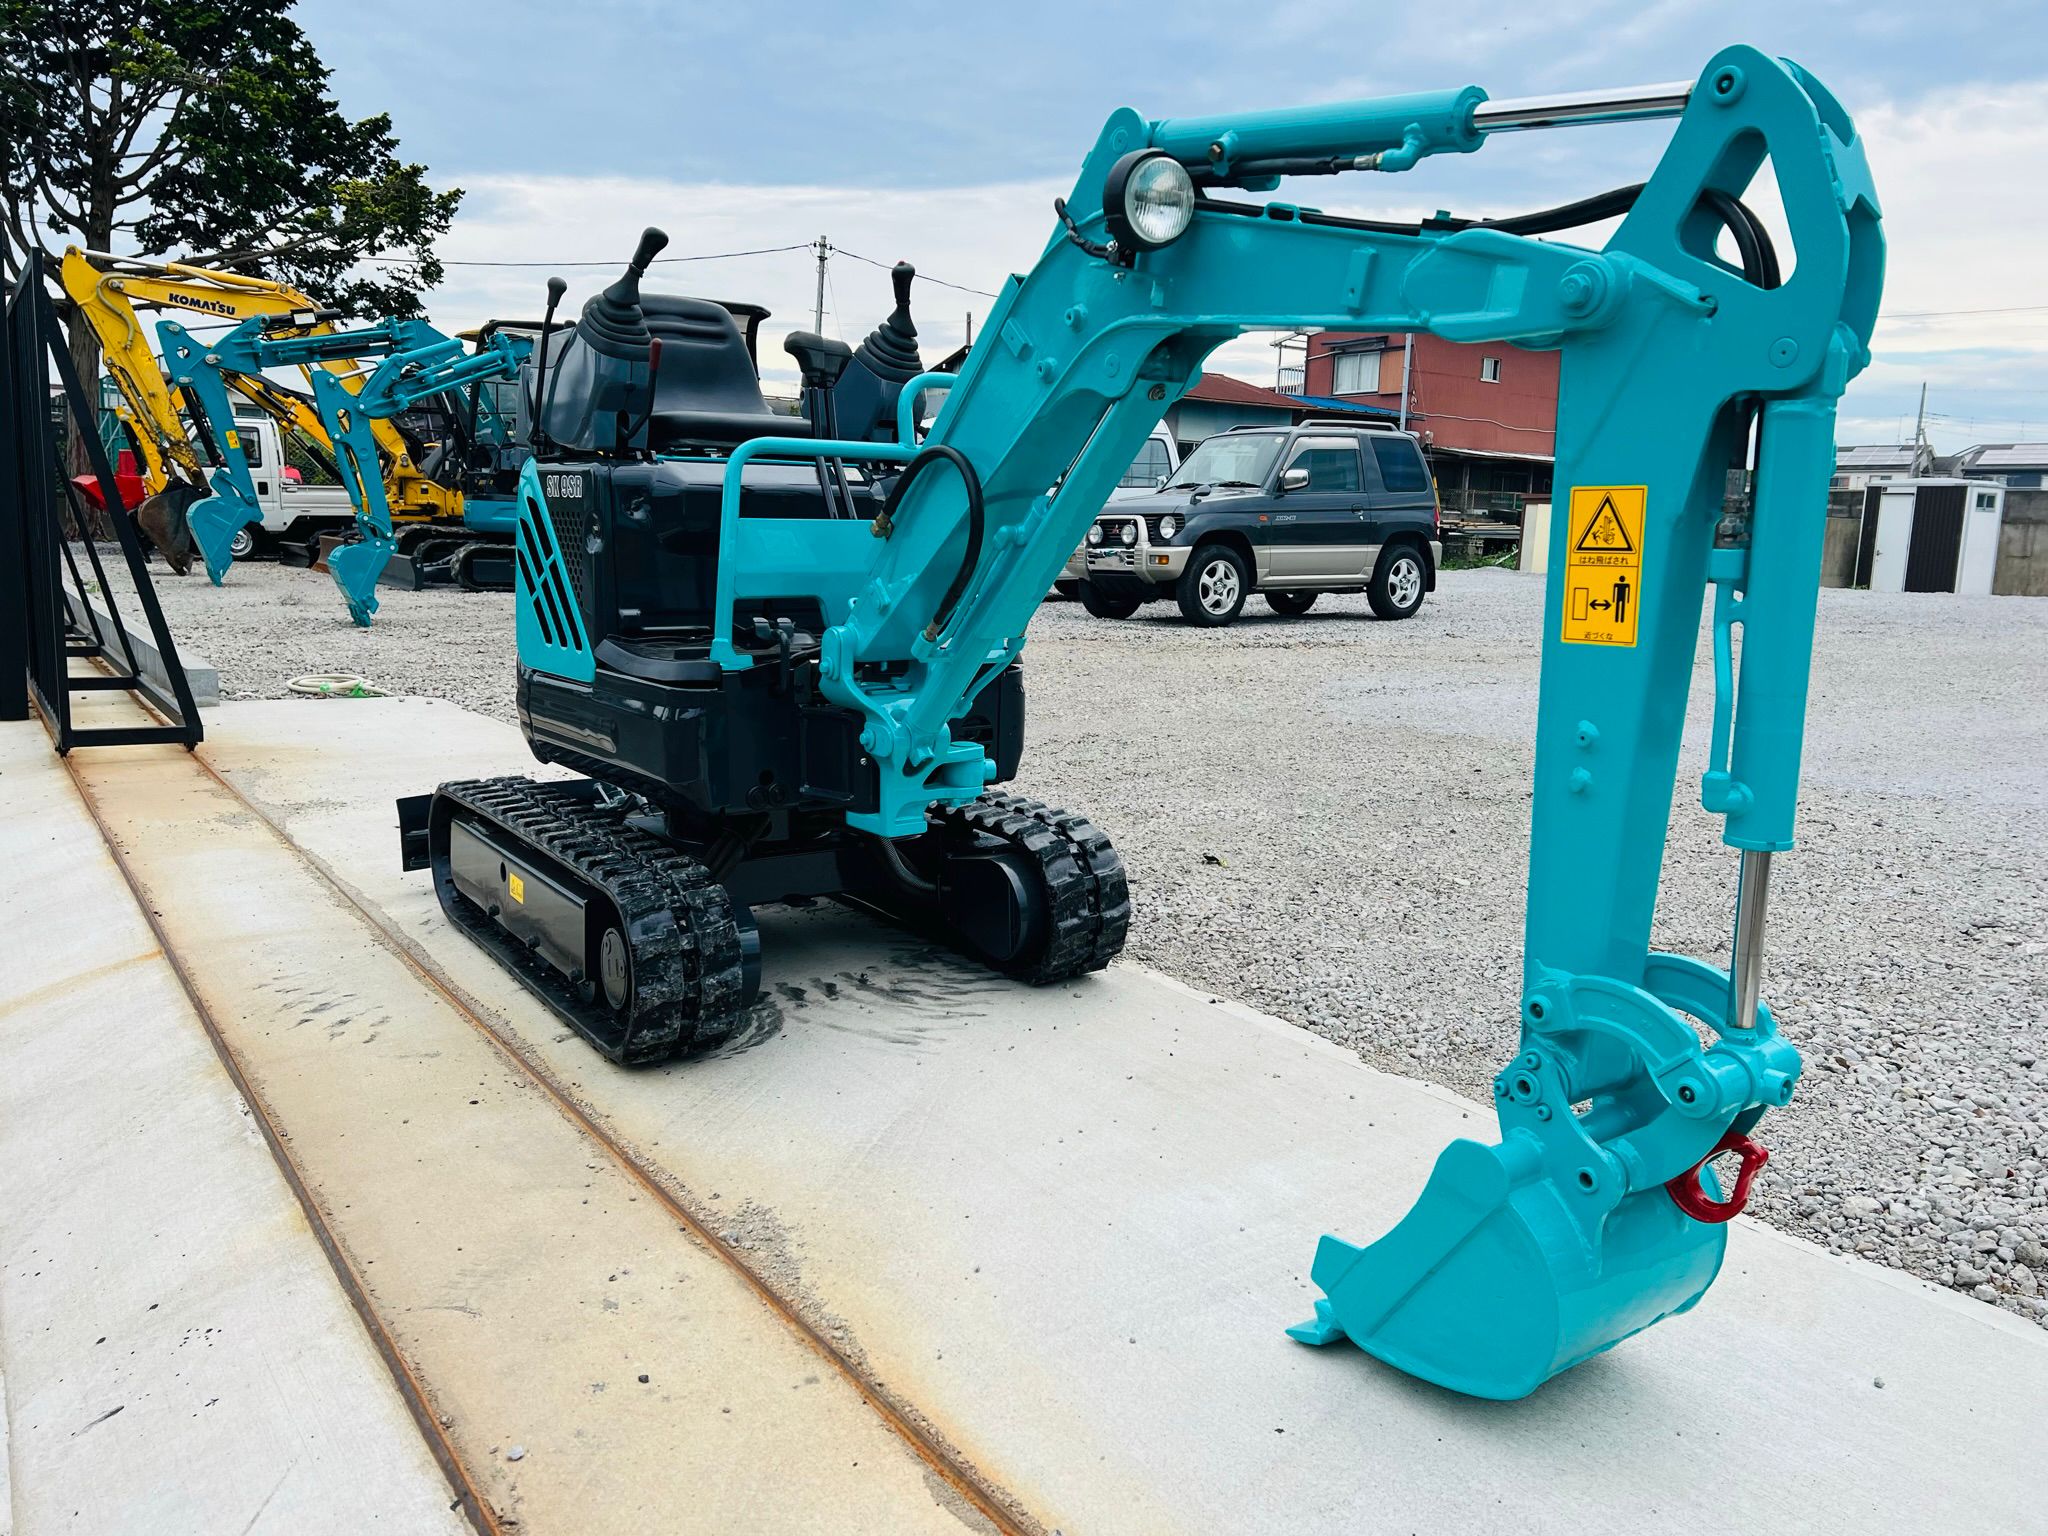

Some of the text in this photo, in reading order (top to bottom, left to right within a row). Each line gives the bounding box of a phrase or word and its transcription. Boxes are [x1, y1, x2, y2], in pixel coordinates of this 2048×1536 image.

[168, 293, 236, 315] KOMATSU
[546, 474, 583, 498] SK 9SR
[1579, 555, 1629, 565] はね飛ばされ
[1584, 631, 1614, 641] 近づくな
